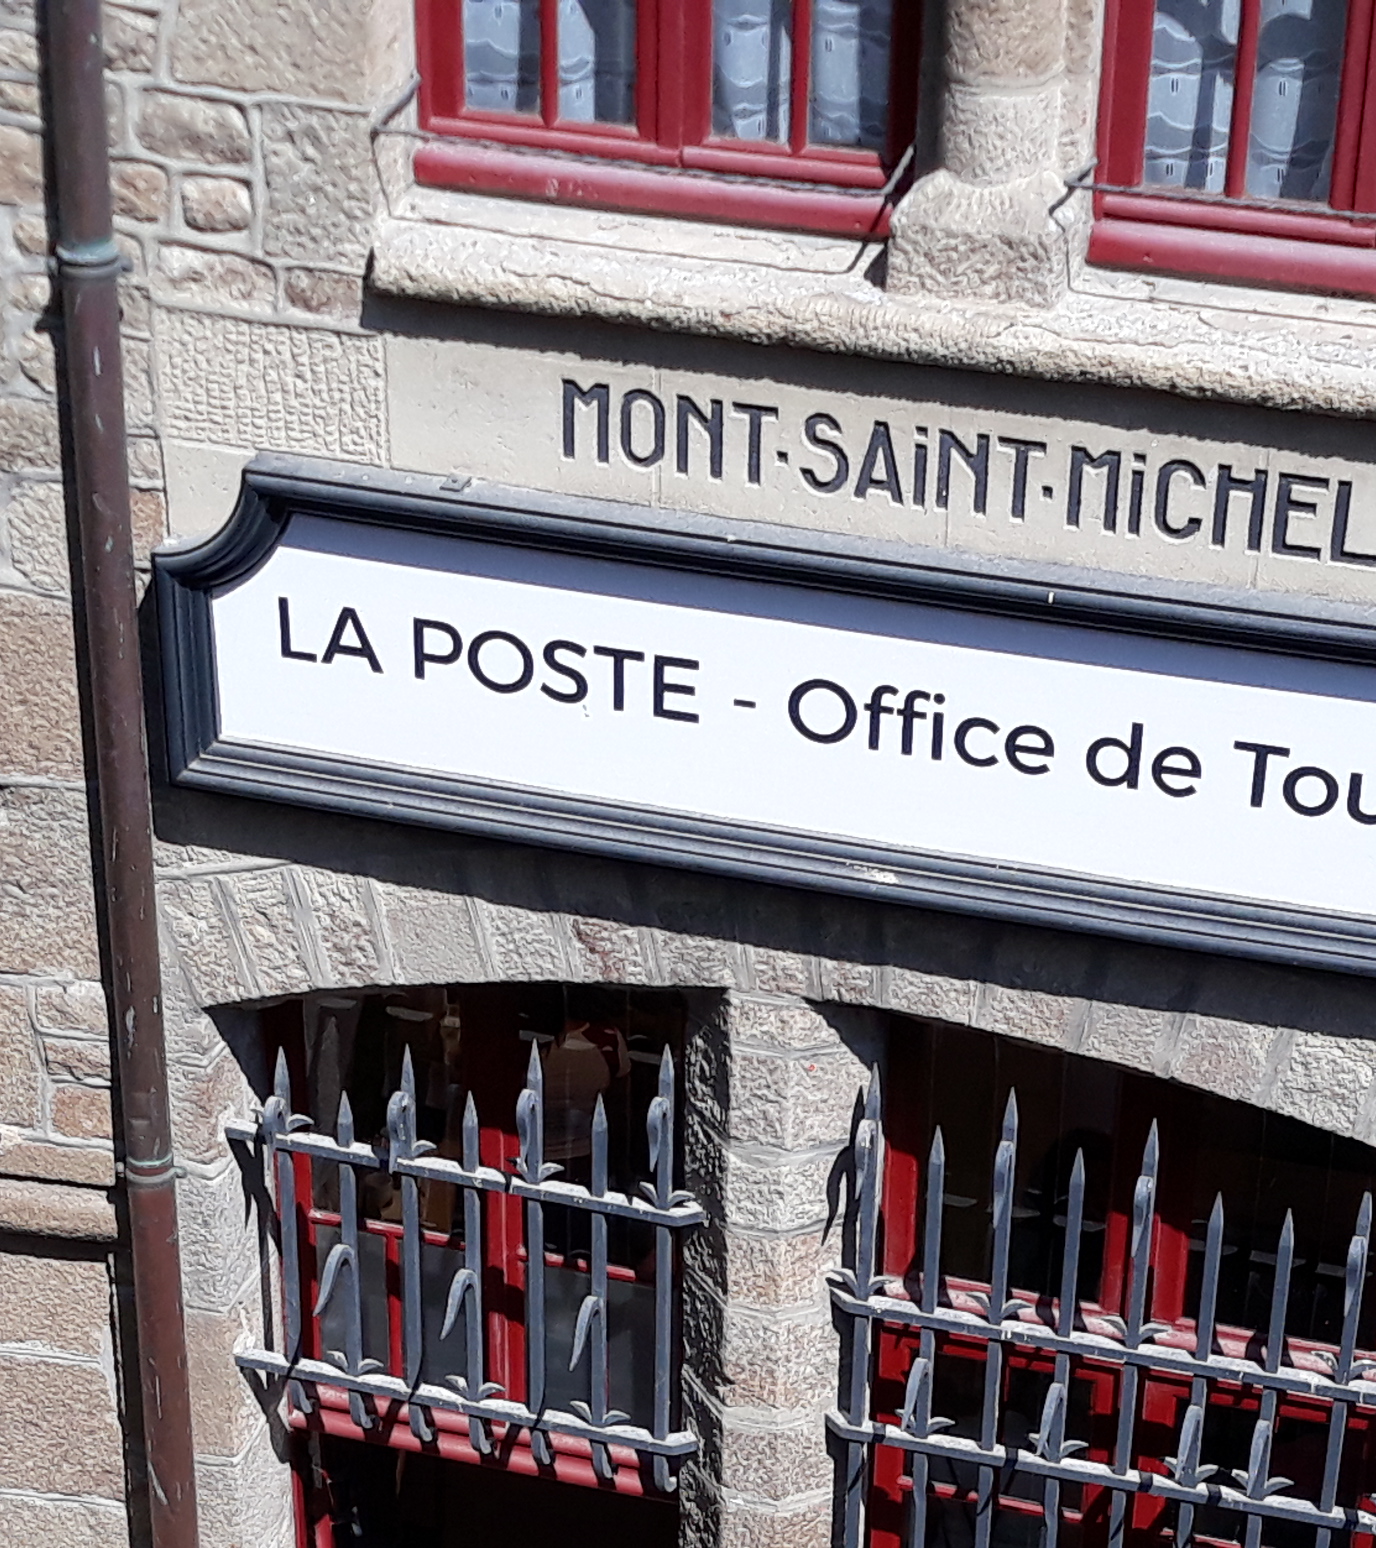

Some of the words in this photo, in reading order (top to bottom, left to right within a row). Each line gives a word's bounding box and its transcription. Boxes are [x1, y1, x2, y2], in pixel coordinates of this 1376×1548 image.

[277, 597, 384, 673] LA
[412, 617, 701, 723] POSTE
[787, 678, 1056, 775] Office
[1085, 723, 1203, 799] de
